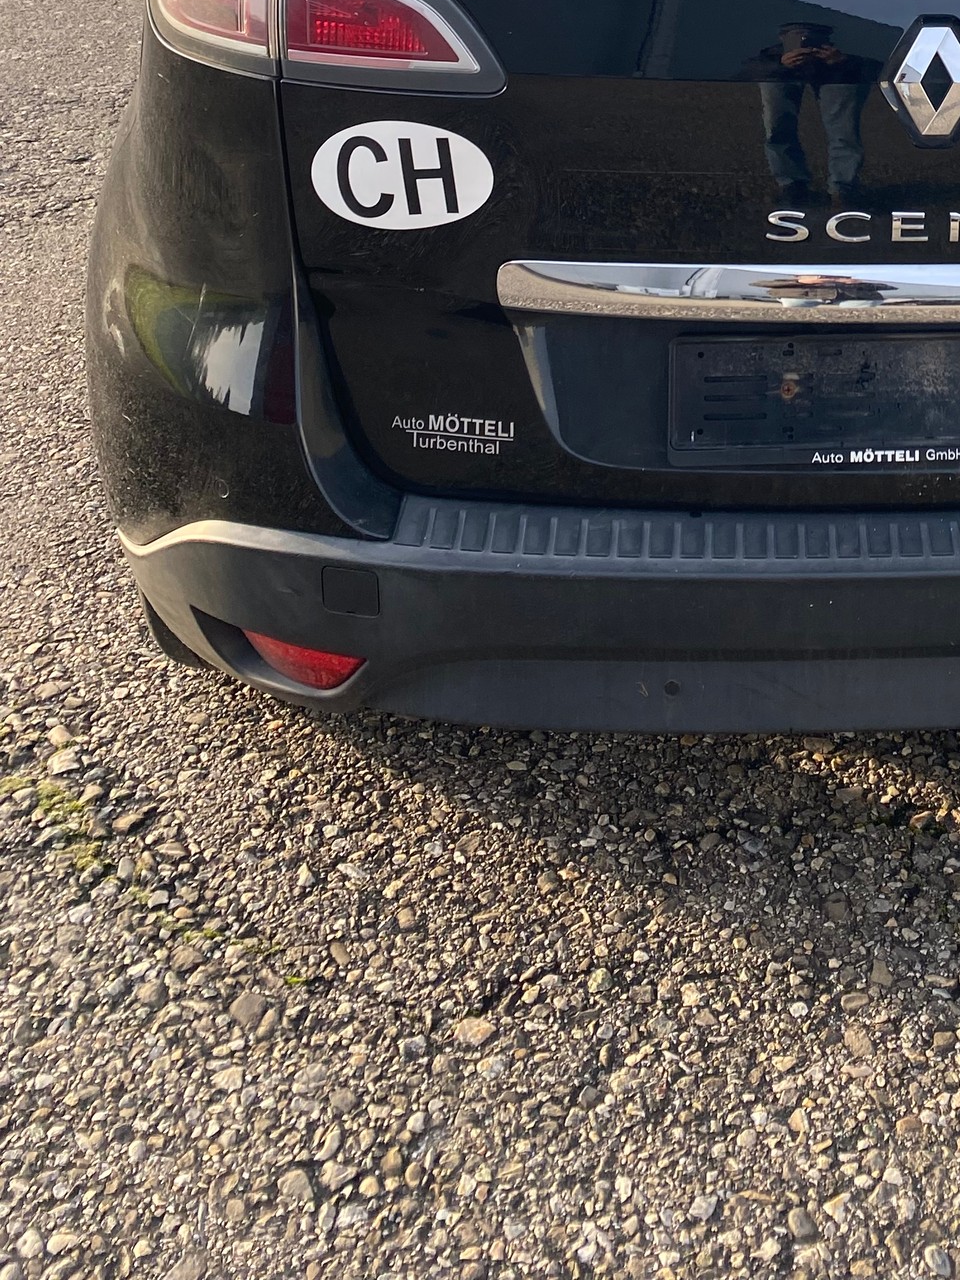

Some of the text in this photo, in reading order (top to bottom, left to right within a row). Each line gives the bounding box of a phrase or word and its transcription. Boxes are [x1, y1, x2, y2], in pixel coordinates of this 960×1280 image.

[336, 135, 460, 219] CH
[391, 413, 515, 438] Auto MÖTTELI
[412, 431, 500, 455] Turbenthal
[811, 452, 844, 464] Auto
[850, 448, 920, 463] MÖTTELI
